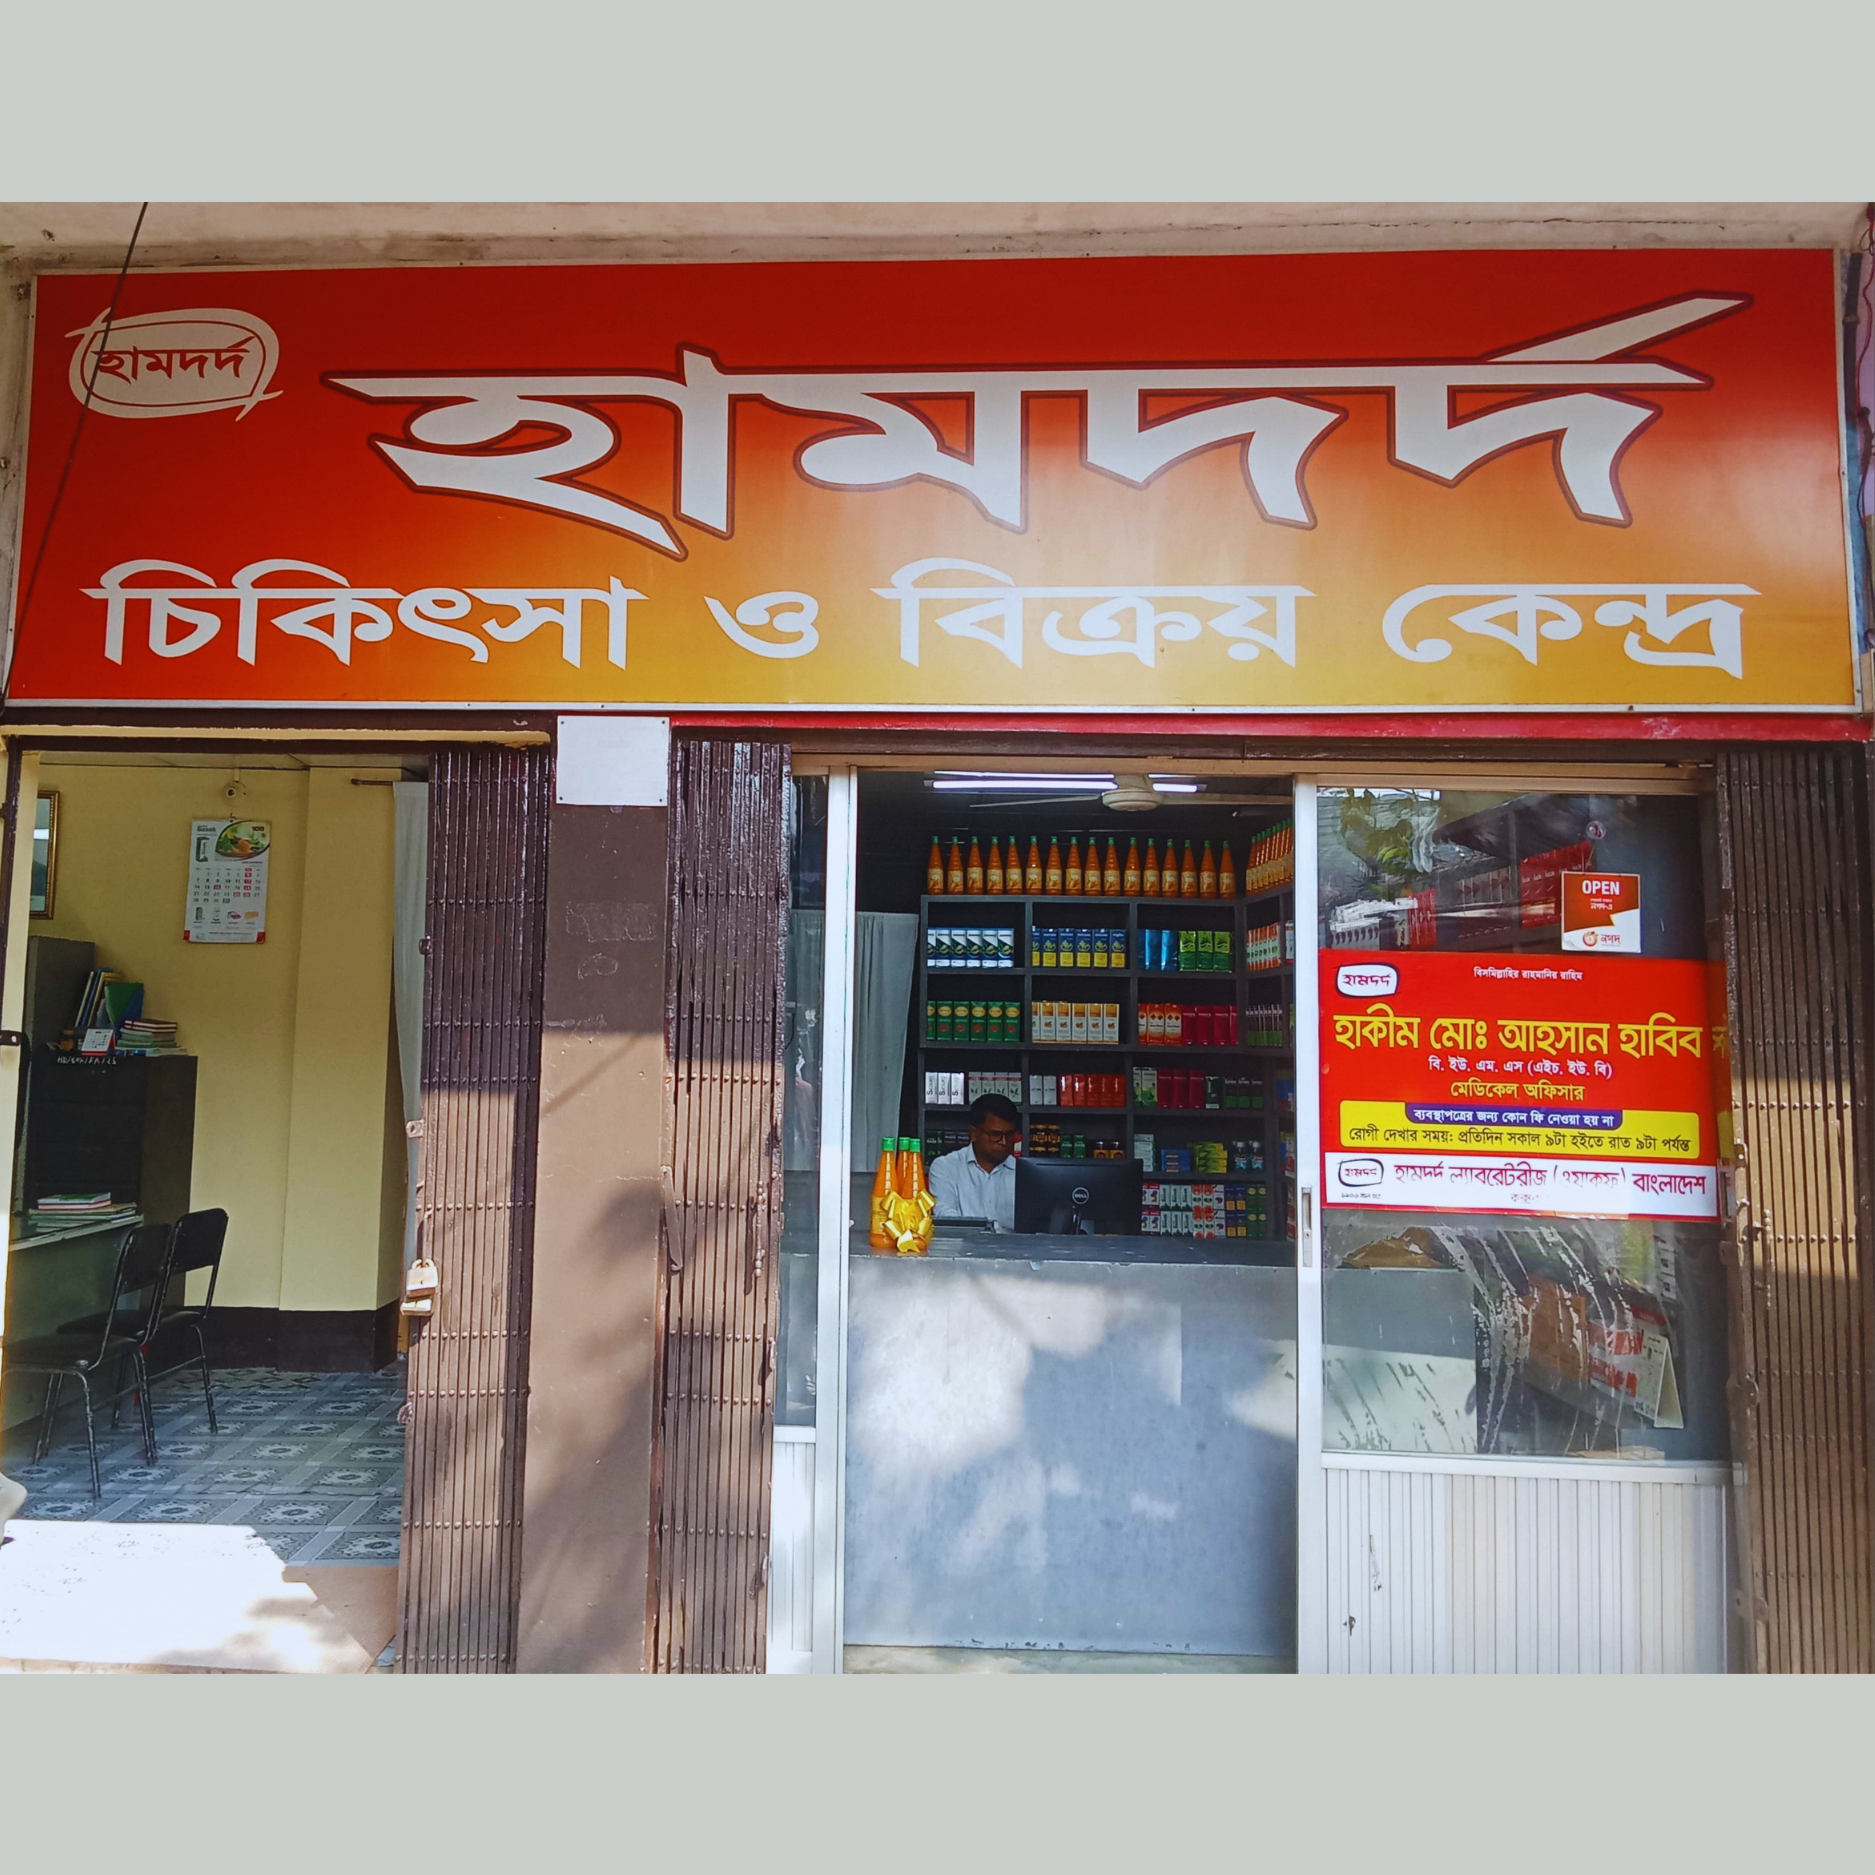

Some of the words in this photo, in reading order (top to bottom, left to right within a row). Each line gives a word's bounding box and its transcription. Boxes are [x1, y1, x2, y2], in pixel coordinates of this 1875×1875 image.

[91, 336, 255, 385] হামদর্দ
[323, 292, 1751, 558] হামদর্দ
[79, 559, 650, 669] চিকিৎসা
[704, 591, 819, 659] ও
[871, 558, 1317, 669] বিক্রয়
[1383, 582, 1761, 680] কেন্দ্র
[1582, 880, 1620, 895] OPEN
[1601, 934, 1621, 944] নগদ
[1474, 966, 1519, 979] বিসমিল্লাহির
[1522, 968, 1557, 980] রাহমানির
[1560, 970, 1583, 981] রাহিম
[1333, 1003, 1421, 1050] হাকীম
[1430, 1018, 1488, 1050] মোঃ
[1497, 1020, 1610, 1056] আহসান
[1618, 1012, 1703, 1059] হাবিব
[1428, 1055, 1444, 1071] বি.
[1448, 1056, 1471, 1072] ইউ.
[1476, 1060, 1498, 1072] এম.
[1503, 1061, 1523, 1073] এস
[1527, 1059, 1563, 1077] (এইচ.
[1567, 1060, 1590, 1076] ইউ.
[1594, 1060, 1613, 1079] বি)
[1450, 1077, 1519, 1098] মেডিকেল
[1523, 1079, 1585, 1101] অফিসার
[1413, 1109, 1473, 1124] ব্যবস্থাপত্রের
[1476, 1111, 1499, 1123] জন্য
[1502, 1111, 1527, 1124] কোন
[1530, 1110, 1544, 1124] ফি
[1548, 1113, 1580, 1126] নেওয়া
[1583, 1114, 1599, 1127] হয়
[1602, 1115, 1614, 1127] না
[1350, 1123, 1379, 1142] রোগী
[1384, 1128, 1417, 1142] দেখার
[1458, 1127, 1503, 1145] প্রতিদিন
[1508, 1132, 1541, 1146] সকাল
[1545, 1130, 1567, 1147] ৯টা
[1570, 1131, 1605, 1149] হইতে
[1608, 1136, 1632, 1150] রাত
[1636, 1134, 1658, 1150] ৯টা
[1661, 1134, 1691, 1152] পর্যন্ত
[1394, 1161, 1444, 1184] হামদর্দ
[1448, 1161, 1547, 1187] ল্যাবরেটরীজ
[1632, 1172, 1707, 1196] বাংলাদেশ
